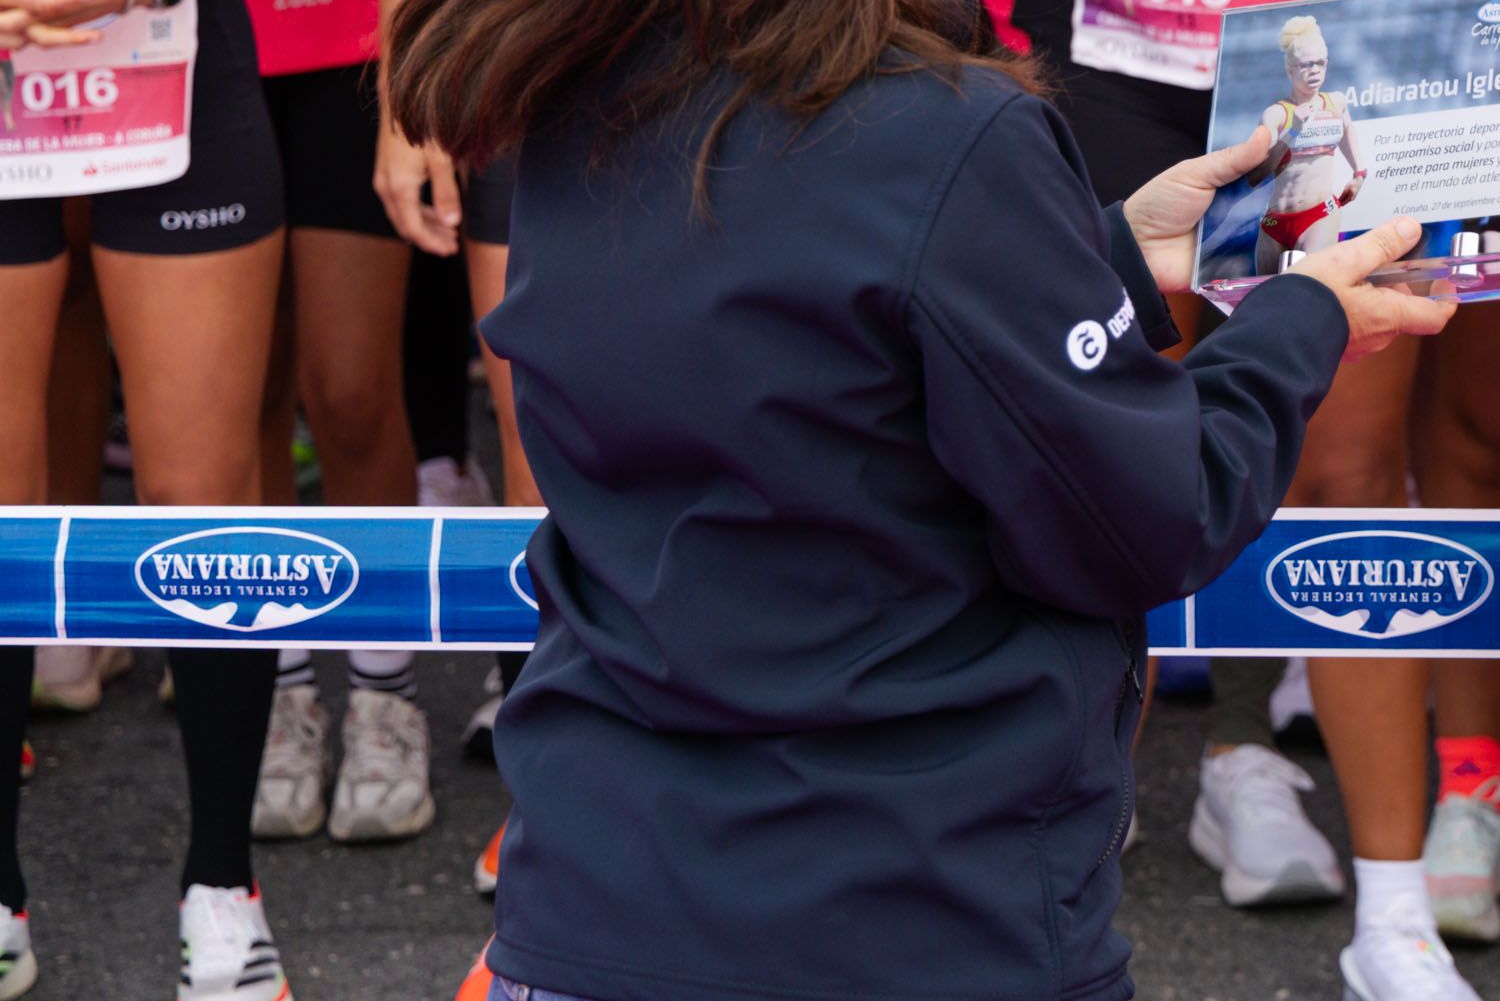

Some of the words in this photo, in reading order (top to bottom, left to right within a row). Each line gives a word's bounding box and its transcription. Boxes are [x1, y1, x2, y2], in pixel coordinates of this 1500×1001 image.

[20, 68, 119, 112] 016
[1345, 77, 1459, 108] Adiaratou
[1374, 134, 1391, 145] Por
[1394, 133, 1405, 144] tu
[1407, 125, 1464, 143] trayectoria
[1375, 144, 1442, 163] compromiso
[1443, 140, 1475, 154] social
[1375, 161, 1424, 179] referente
[1425, 162, 1450, 176] para
[1452, 157, 1495, 171] mujeres
[1394, 183, 1408, 194] en
[1409, 179, 1420, 191] el
[1421, 175, 1460, 190] mundo
[1461, 172, 1478, 185] del
[160, 203, 246, 231] OYSHO
[1393, 206, 1400, 216] A
[1432, 201, 1442, 211] 27
[1442, 200, 1451, 210] de
[1453, 196, 1495, 211] septiembre
[152, 553, 344, 595] ASTURIANA
[1283, 559, 1477, 601] ASTURIANA
[160, 584, 231, 596] LECHERA
[237, 585, 309, 597] CENTRAL
[1291, 591, 1364, 602] LECHERA
[1370, 592, 1443, 603] CENTRAL
